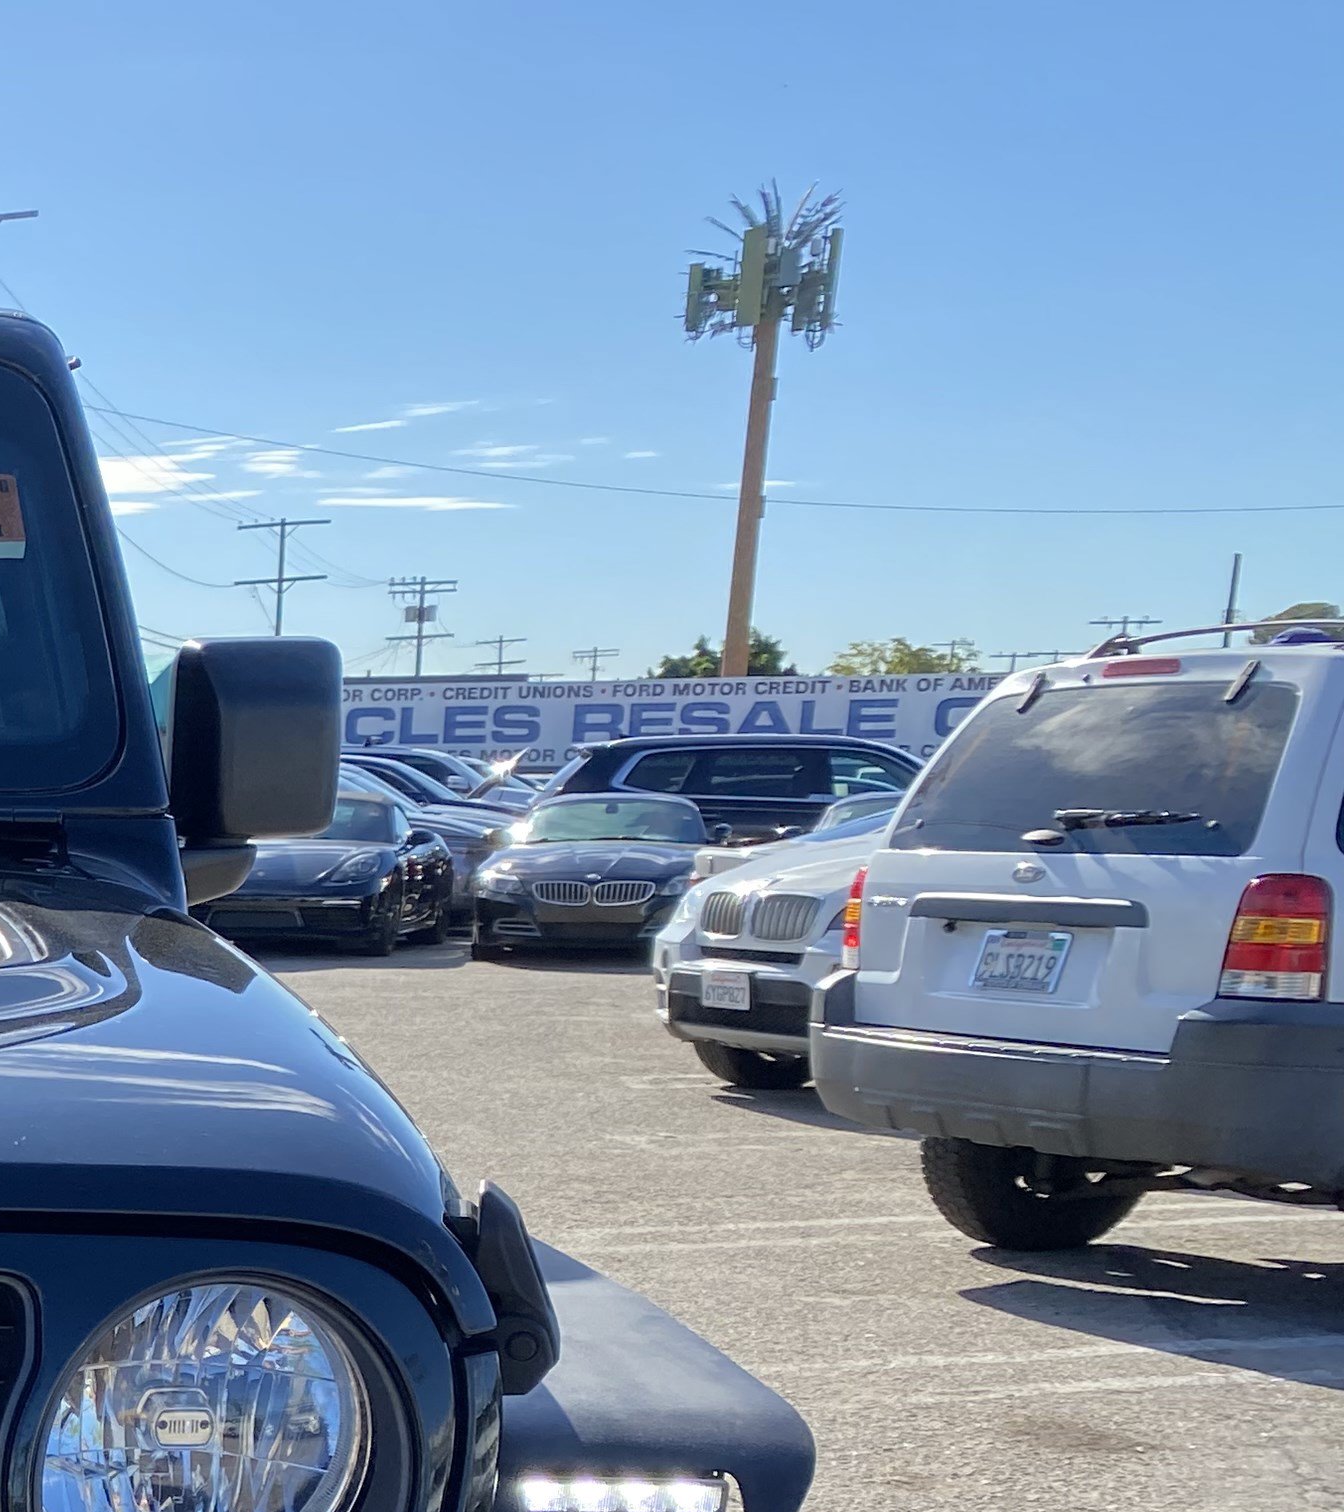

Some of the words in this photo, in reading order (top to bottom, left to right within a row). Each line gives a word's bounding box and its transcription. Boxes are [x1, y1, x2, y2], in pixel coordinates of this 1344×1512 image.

[370, 688, 423, 701] CORP.
[442, 687, 512, 700] CREDIT
[518, 685, 594, 699] UNIONS
[612, 684, 665, 697] FORD
[672, 682, 747, 696] MOTOR
[754, 680, 832, 695] CREDIT
[848, 679, 908, 693] BANK
[916, 678, 944, 692] OF
[572, 698, 900, 742] RESALE
